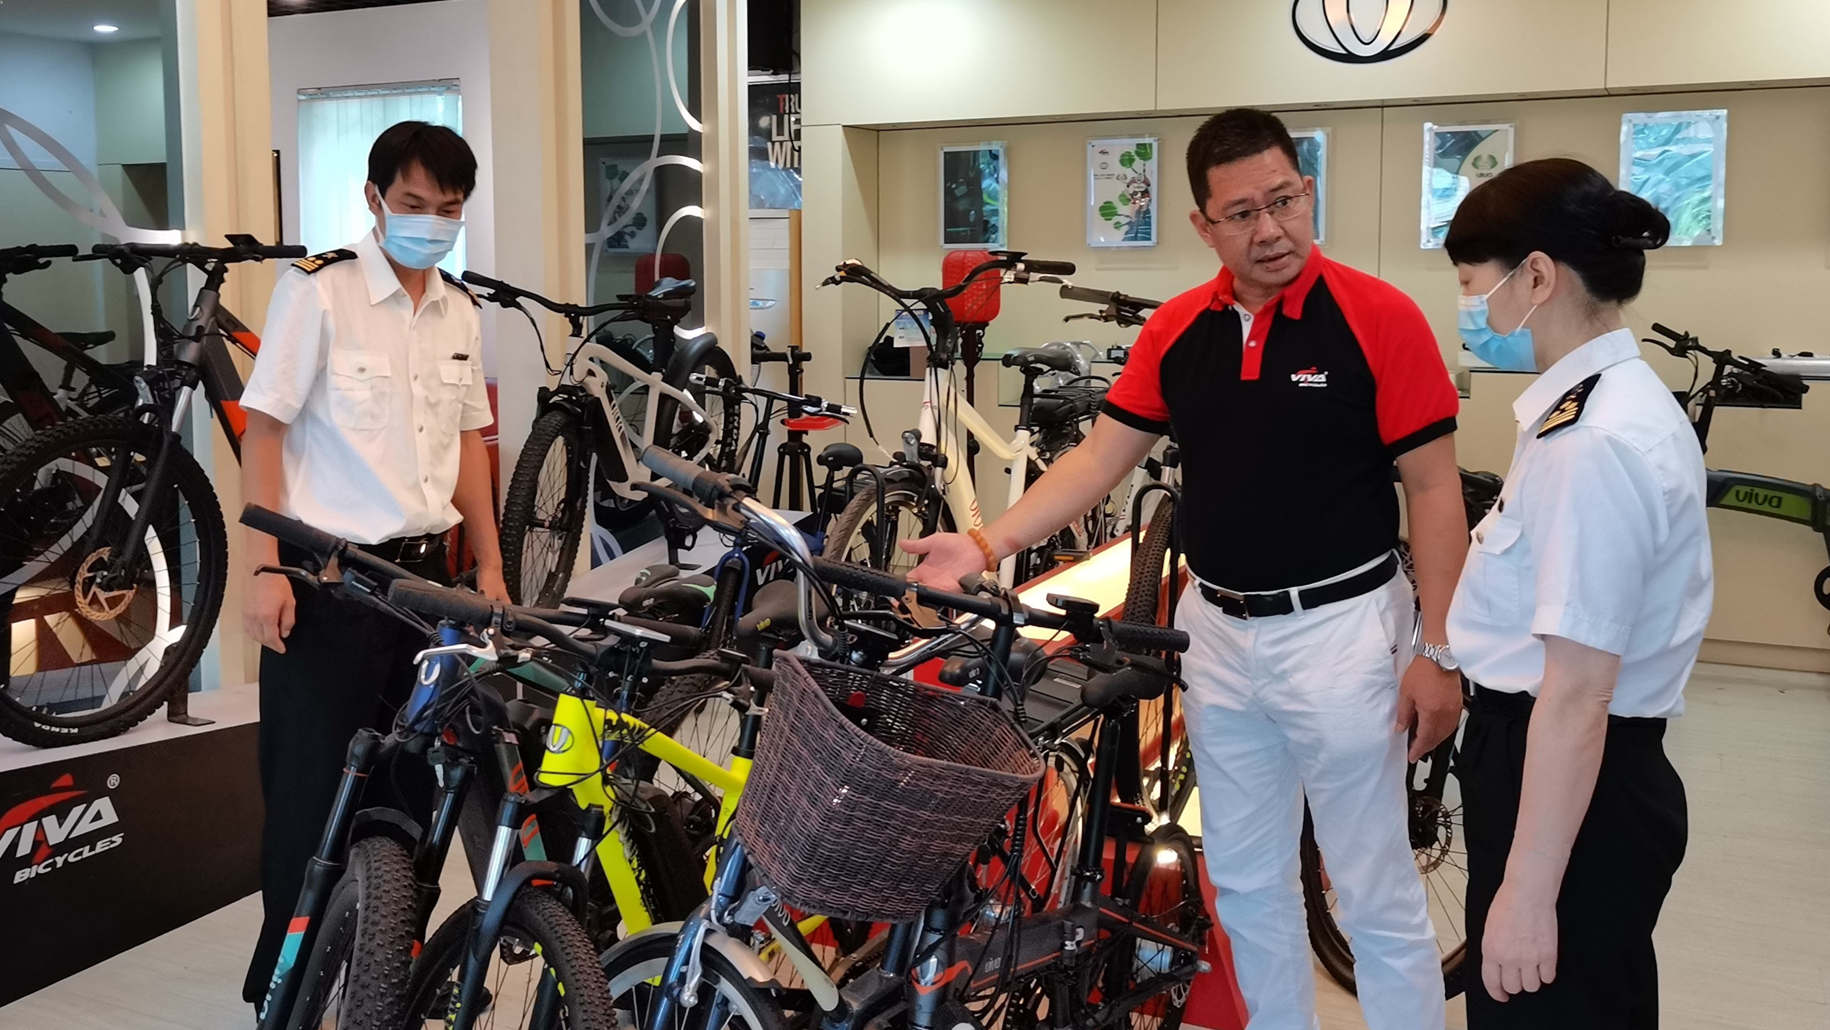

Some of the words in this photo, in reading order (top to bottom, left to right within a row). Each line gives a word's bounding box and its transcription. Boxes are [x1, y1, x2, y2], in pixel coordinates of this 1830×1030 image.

[1290, 373, 1327, 382] VIVA
[1735, 488, 1784, 509] viva
[33, 720, 79, 734] KENDA
[13, 832, 125, 885] BICYCLES
